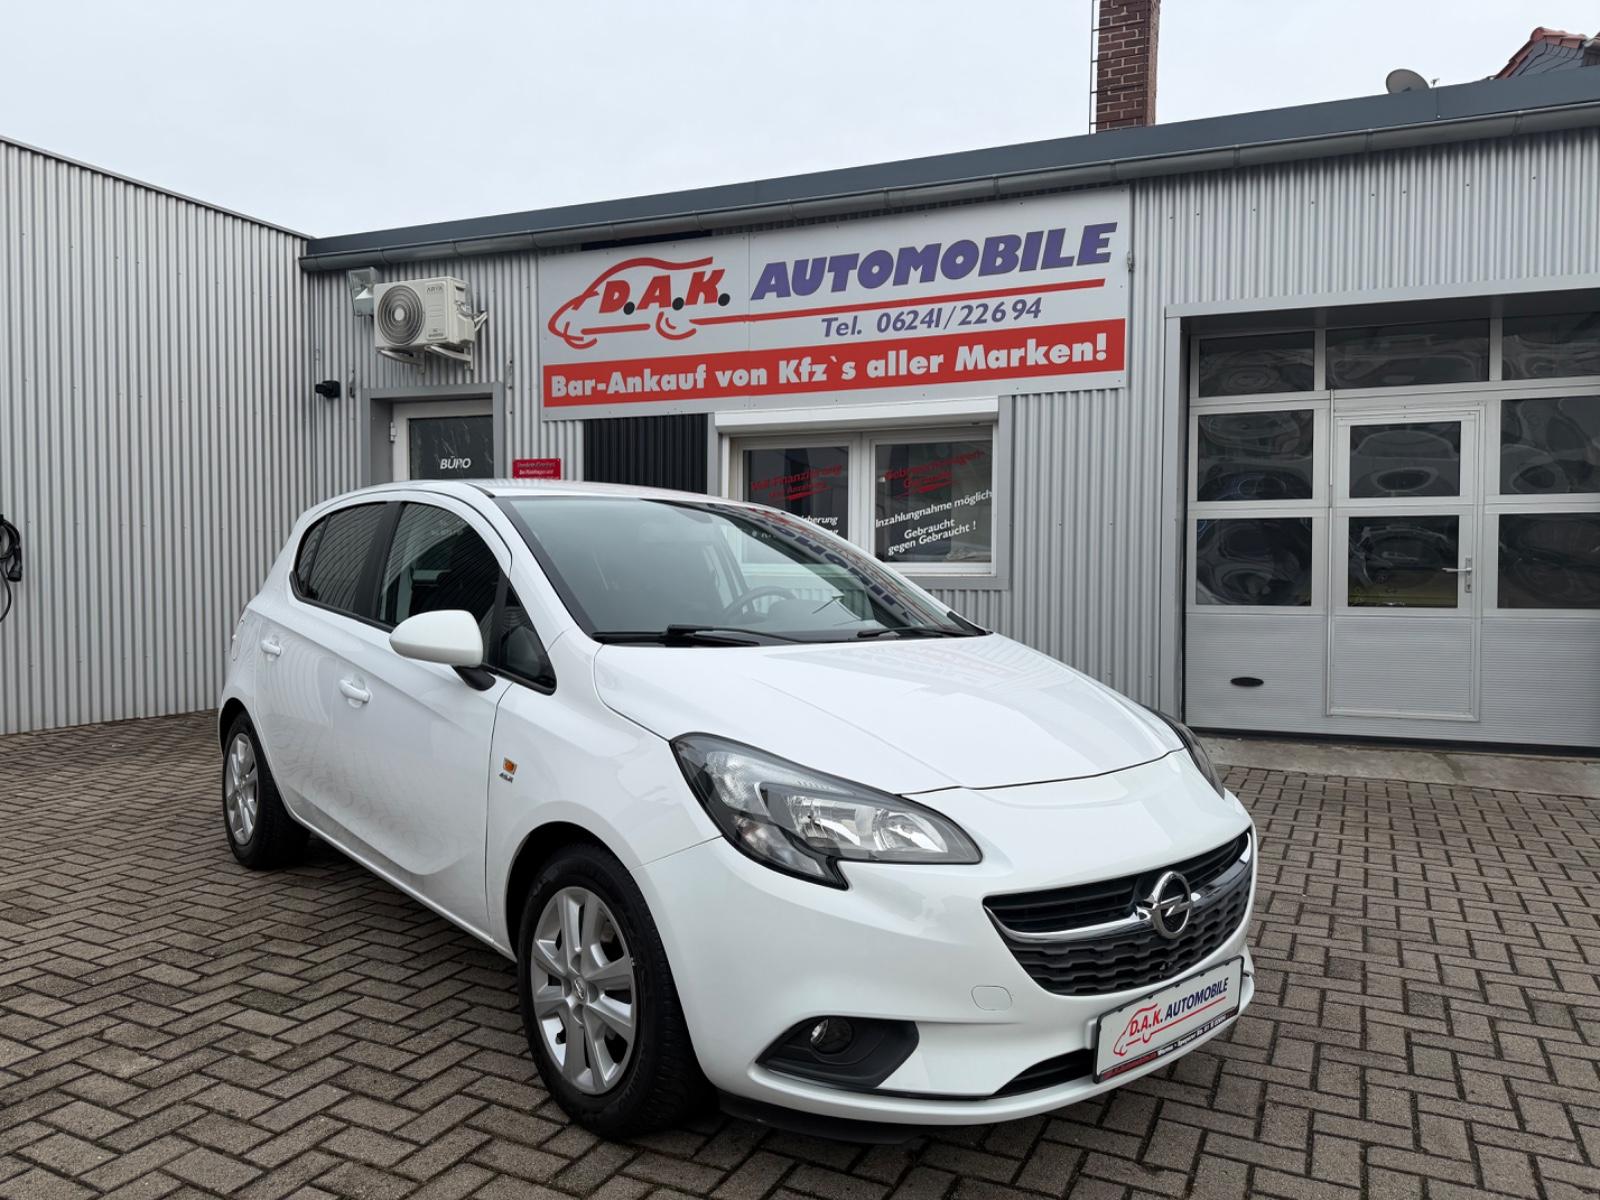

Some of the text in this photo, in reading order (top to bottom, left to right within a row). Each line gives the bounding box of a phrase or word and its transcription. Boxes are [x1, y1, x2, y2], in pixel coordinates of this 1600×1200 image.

[598, 222, 1118, 315] D.A.K. AUTOMOBILE
[821, 315, 862, 338] Tel.
[551, 364, 706, 398] Bar-Ankauf
[715, 368, 767, 388] von
[866, 350, 944, 379] aller
[954, 333, 1107, 372] Marken!
[440, 455, 471, 469] BÜRO
[875, 501, 952, 528] Inzahlungnahme
[904, 519, 955, 539] Gebraucht
[888, 540, 916, 556] gegen
[919, 525, 969, 544] Gebraucht
[1129, 1009, 1162, 1037] D.A.K.
[1163, 977, 1229, 1020] AUTOMOBILE
